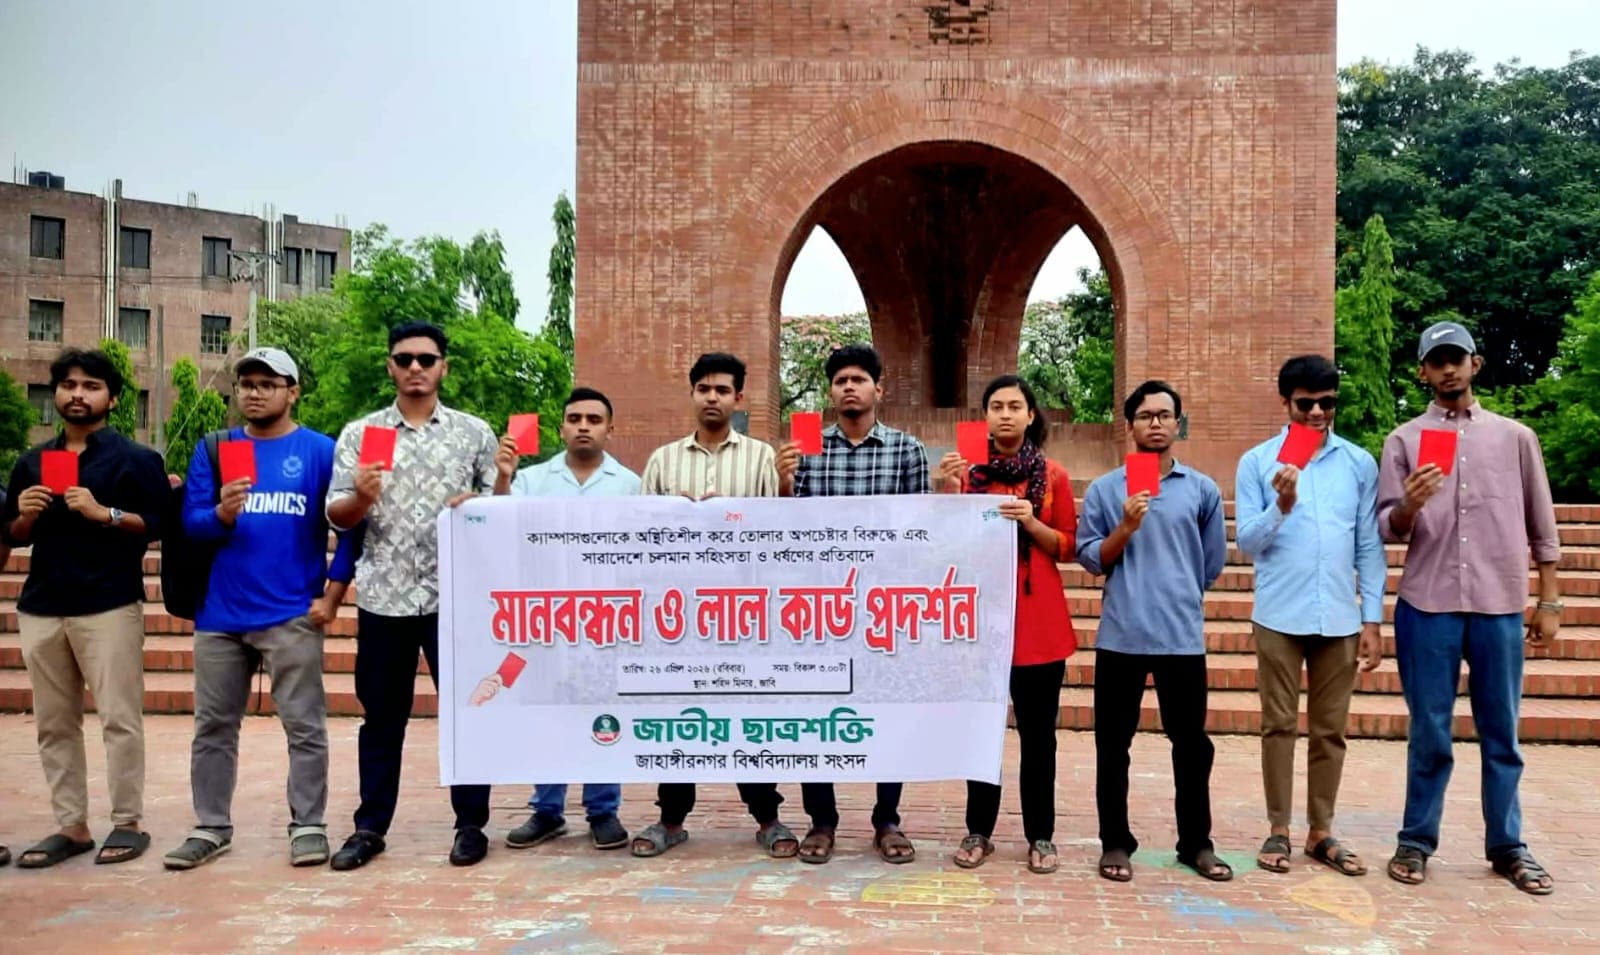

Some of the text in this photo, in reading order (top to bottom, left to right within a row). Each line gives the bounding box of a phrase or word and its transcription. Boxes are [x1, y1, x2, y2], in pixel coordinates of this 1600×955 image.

[242, 492, 307, 516] NOMICS
[528, 526, 928, 545] ক্যাম্পাসগুলোকে অস্থিতিশীল করে তোলার অপচেষ্টার বিরুদ্ধে এবং
[582, 546, 874, 564] সারাদেশে চলমান সহিংসতা ও ধর্ষণের প্রতিবাদে
[655, 589, 684, 639] ও
[697, 588, 768, 640] লাল
[780, 569, 855, 639] কার্ড
[866, 568, 977, 651] প্রদর্শন
[633, 706, 874, 746] জাতীয় ছাত্রশক্তি
[635, 748, 867, 769] জাহাঙ্গীরনগর বিশ্ববিদ্যালয় সংসদ
